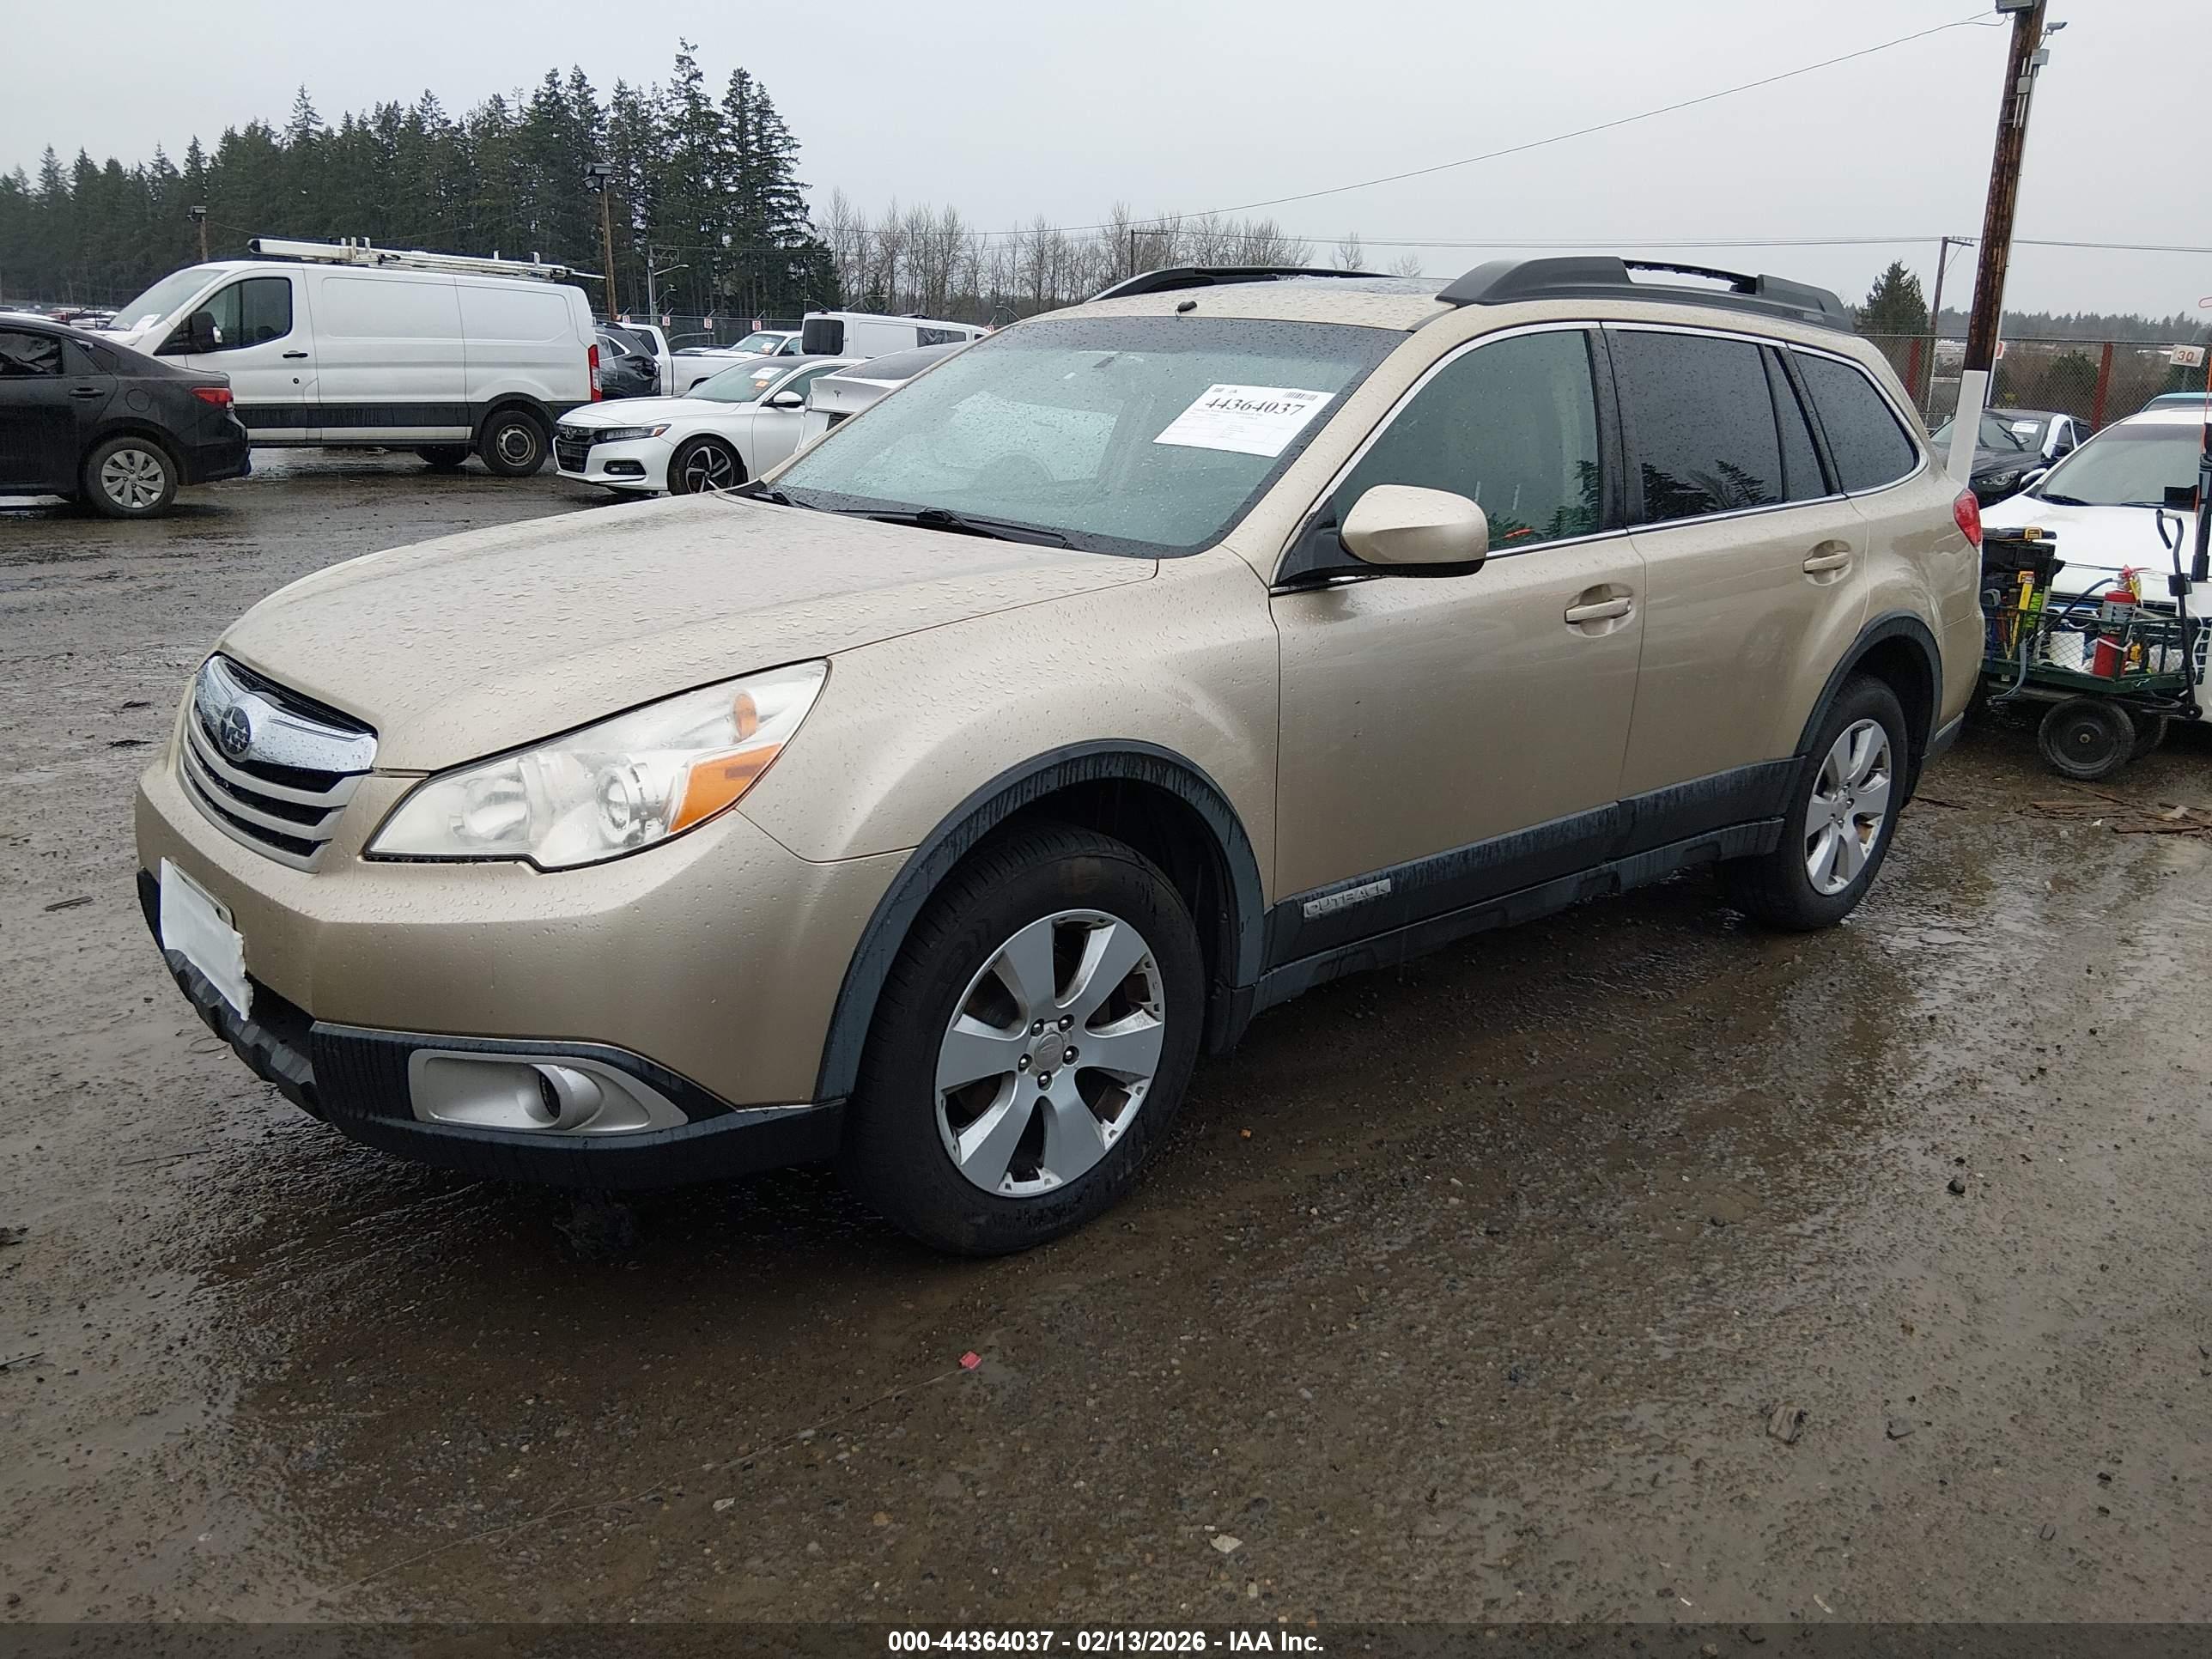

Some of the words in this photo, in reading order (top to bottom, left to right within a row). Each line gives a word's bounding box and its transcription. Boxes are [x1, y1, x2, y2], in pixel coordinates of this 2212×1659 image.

[754, 321, 761, 331] 16
[2177, 350, 2195, 362] 30
[1205, 398, 1306, 416] 44364037
[1304, 880, 1389, 916] OUTBACK
